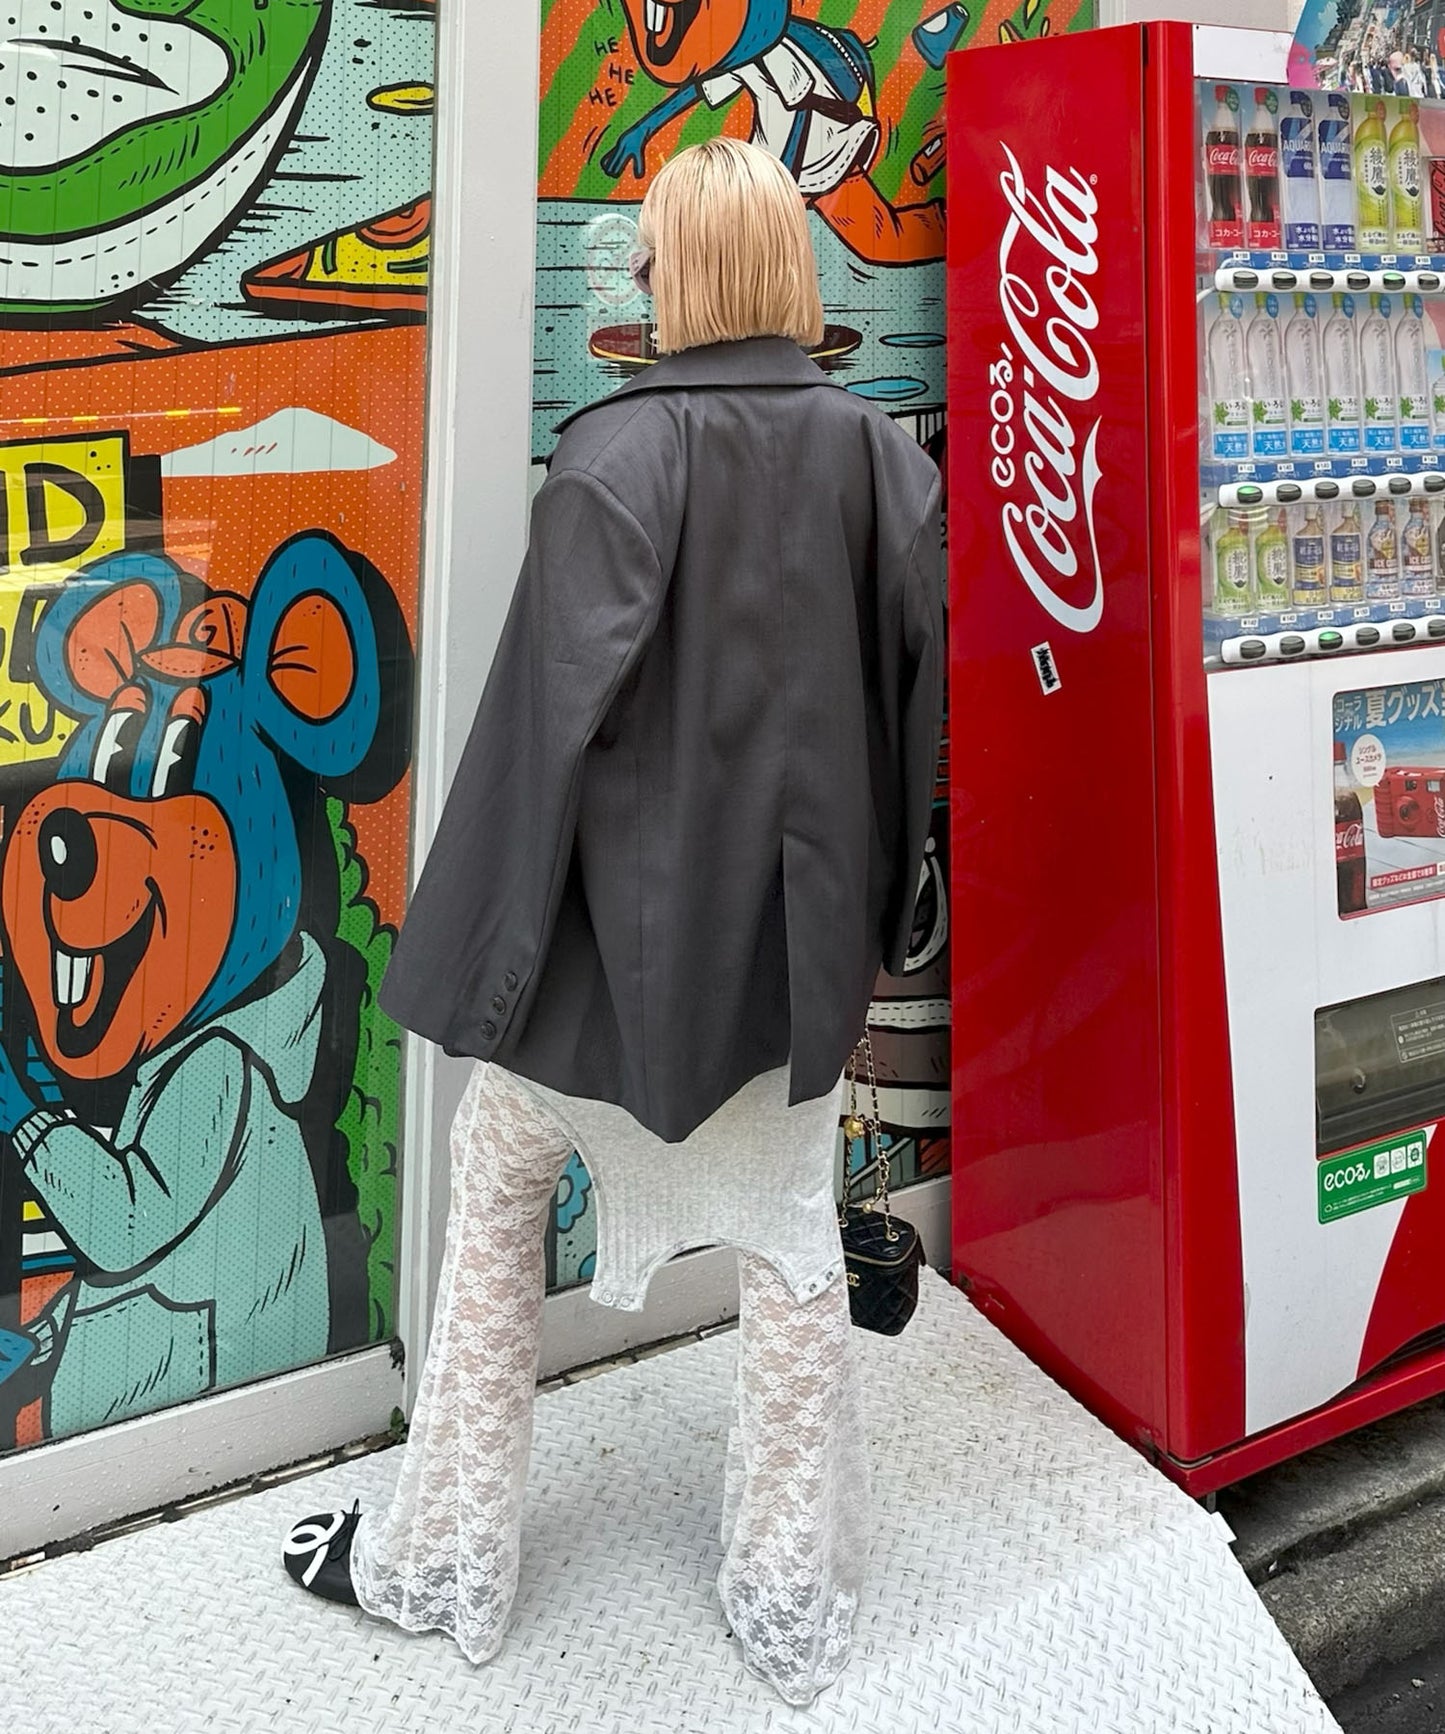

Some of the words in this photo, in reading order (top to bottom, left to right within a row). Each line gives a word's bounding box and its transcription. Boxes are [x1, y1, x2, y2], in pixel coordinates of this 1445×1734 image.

[593, 36, 619, 56] HE
[608, 62, 635, 85] HE
[588, 87, 617, 107] HE
[1000, 141, 1103, 633] Coca-Cola
[1365, 681, 1445, 729] 夏グッズ
